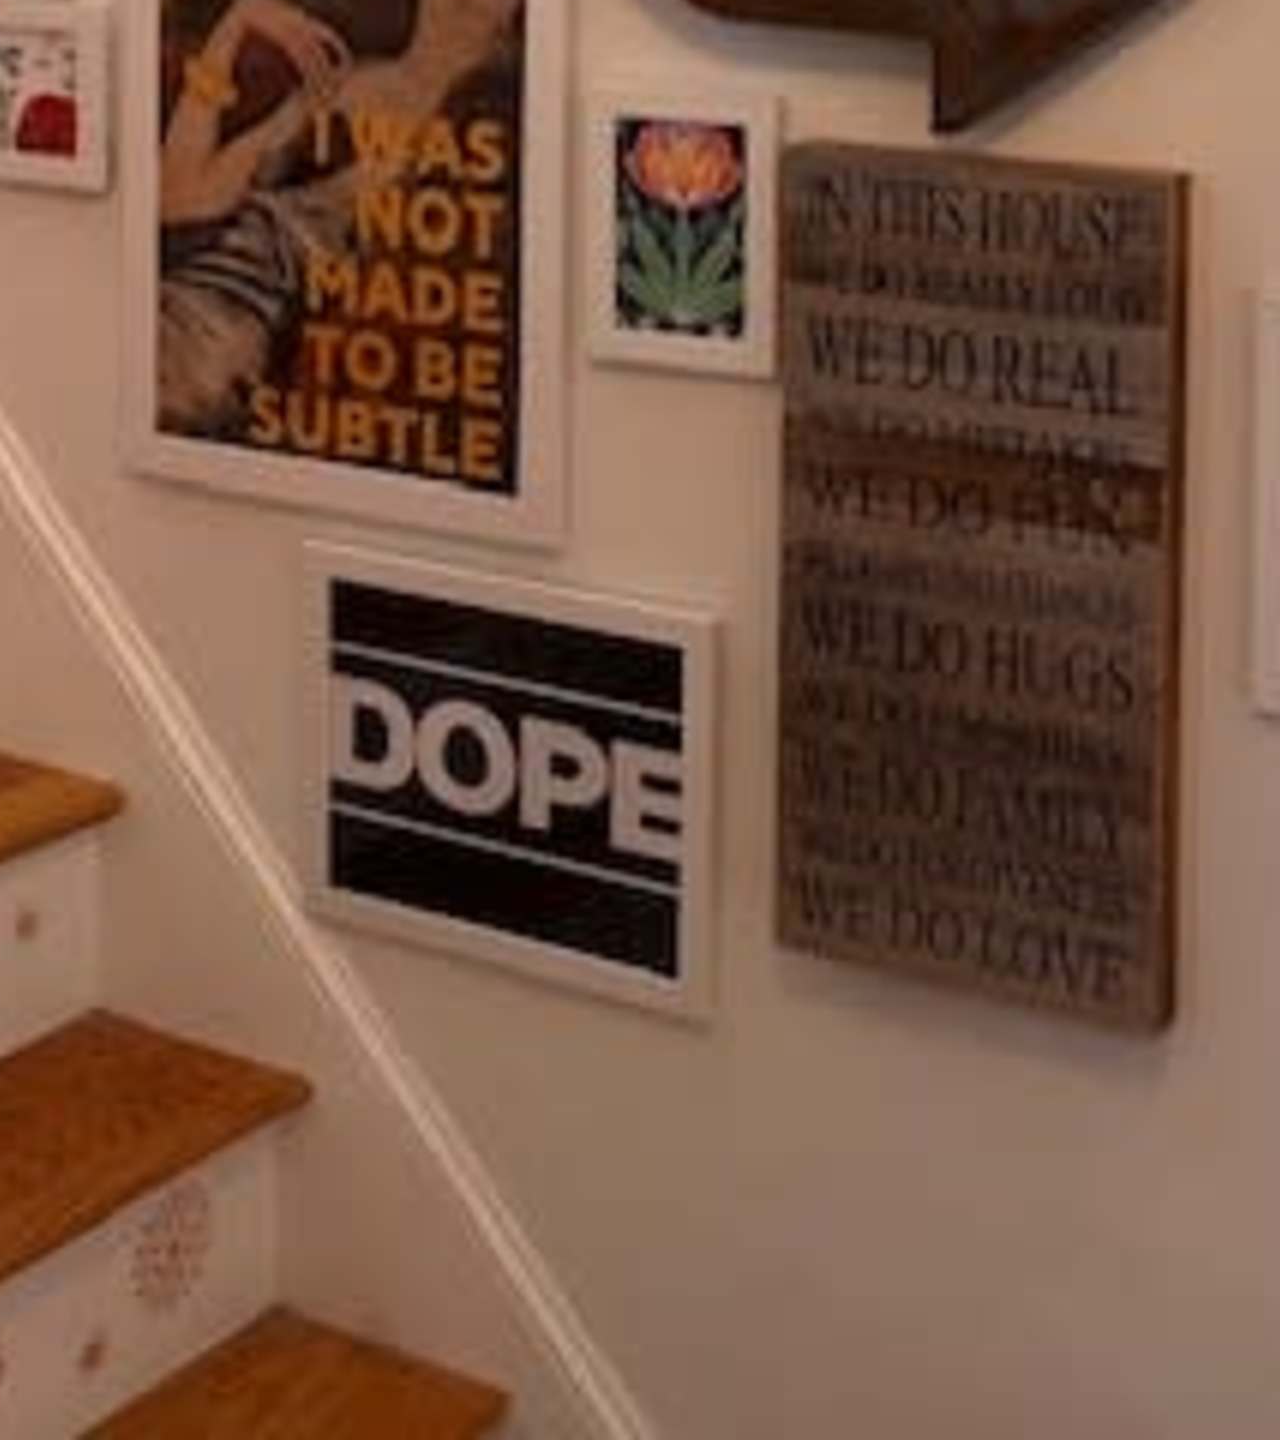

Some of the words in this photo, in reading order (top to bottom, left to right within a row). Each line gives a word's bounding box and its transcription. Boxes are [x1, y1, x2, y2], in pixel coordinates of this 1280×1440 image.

[311, 106, 331, 166] I
[352, 110, 506, 182] WAS
[355, 188, 505, 258] NOT
[871, 178, 968, 242] THIS
[978, 188, 1154, 264] HOUSE
[306, 259, 505, 333] MADE
[303, 325, 396, 391] TO
[414, 340, 504, 407] BE
[805, 313, 882, 386] WE
[902, 322, 978, 393] DO
[991, 335, 1142, 416] REAL
[249, 383, 505, 480] SUBTLE
[805, 458, 888, 518] WE
[908, 472, 991, 536] DO
[801, 594, 880, 666] WE
[893, 606, 970, 679] DO
[984, 624, 1135, 714] HUGS
[330, 672, 683, 861] DOPE
[799, 872, 874, 940] WE
[891, 887, 967, 962] DO
[980, 915, 1130, 1000] LOVE
